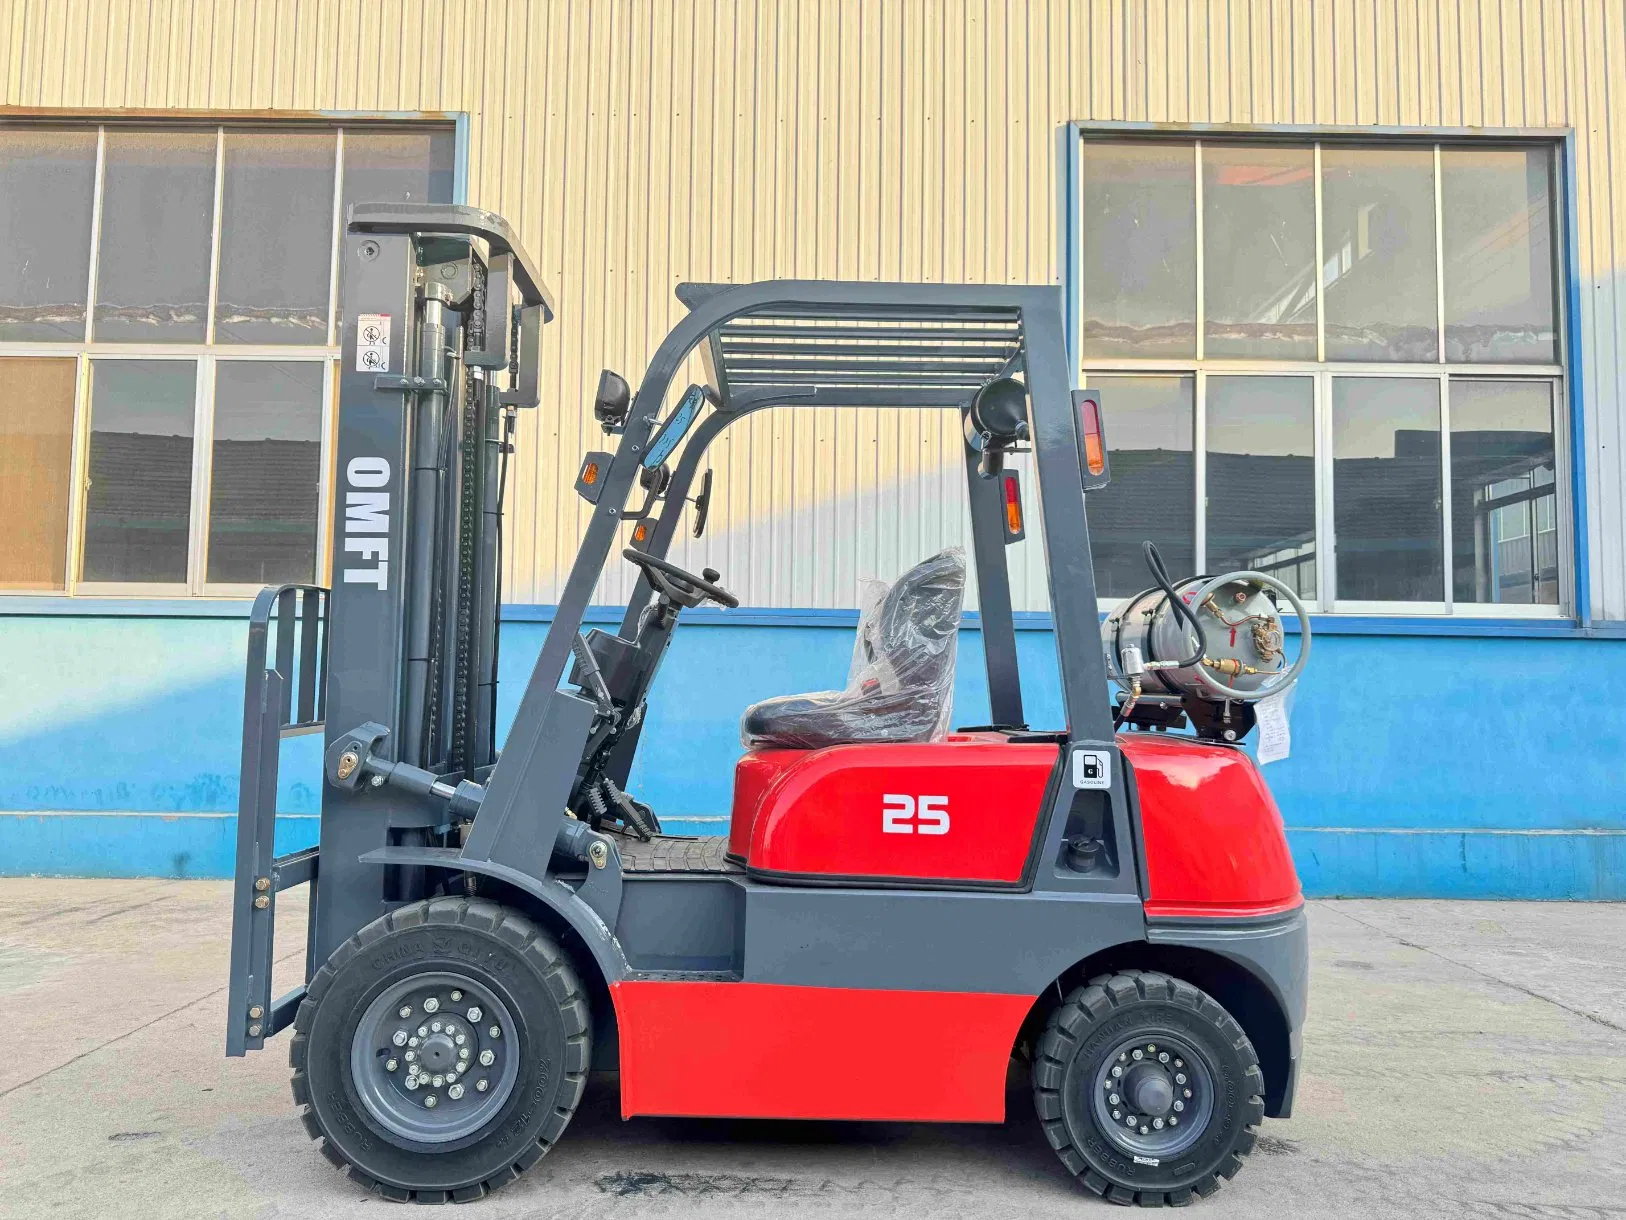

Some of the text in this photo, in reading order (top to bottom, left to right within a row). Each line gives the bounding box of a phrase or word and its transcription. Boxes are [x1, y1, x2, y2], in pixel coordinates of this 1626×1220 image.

[343, 456, 391, 591] OMFT
[882, 793, 951, 836] 25
[328, 1091, 372, 1154] RUBBER
[1087, 1138, 1137, 1177] RUBBER
